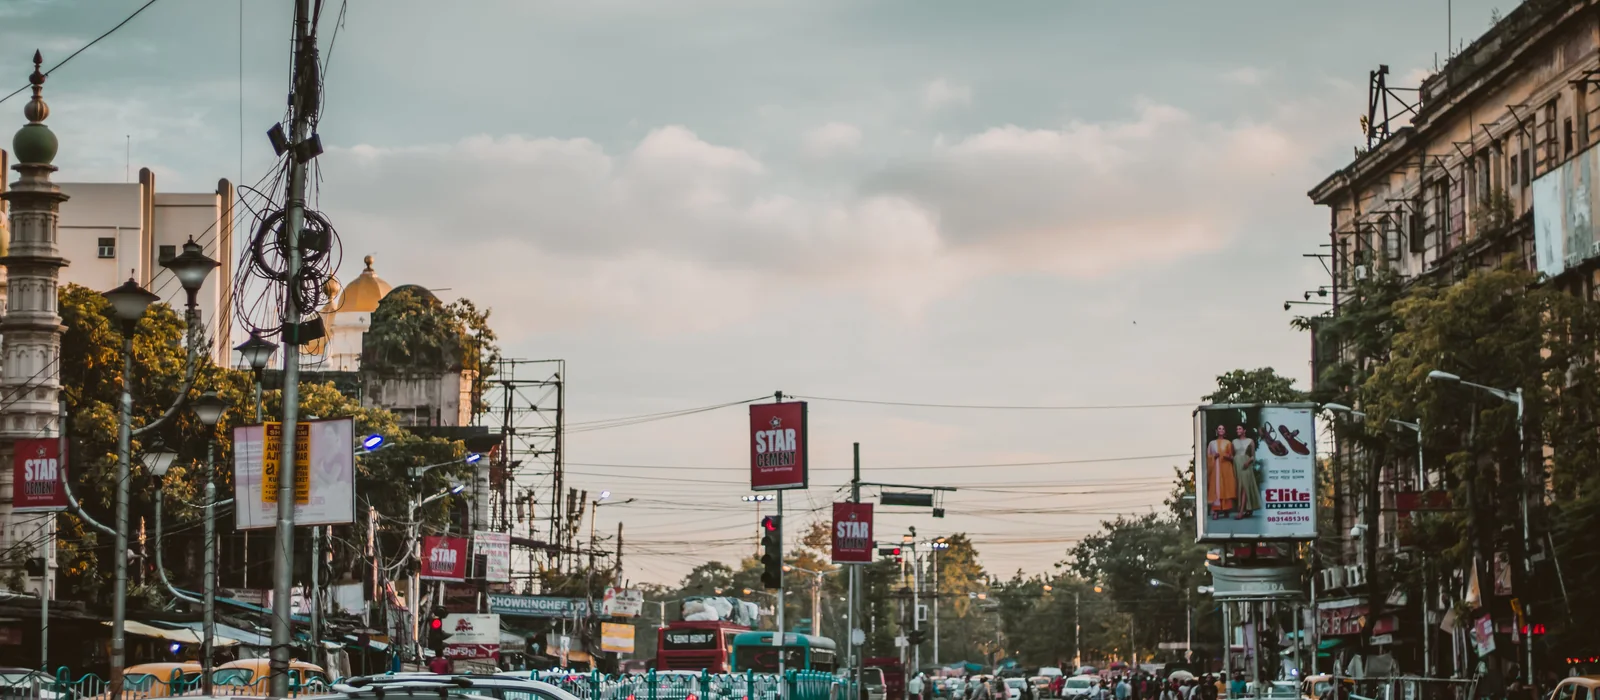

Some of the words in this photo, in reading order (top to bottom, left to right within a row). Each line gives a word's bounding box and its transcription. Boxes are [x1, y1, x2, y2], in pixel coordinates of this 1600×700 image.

[756, 429, 796, 453] STAR
[757, 452, 796, 468] CEMENT
[25, 459, 57, 480] STAR
[25, 481, 56, 495] CEMENT
[1265, 488, 1310, 501] Elite
[837, 521, 868, 538] STAR
[431, 548, 457, 563] STAR
[491, 597, 568, 610] CHOWRINGHEE
